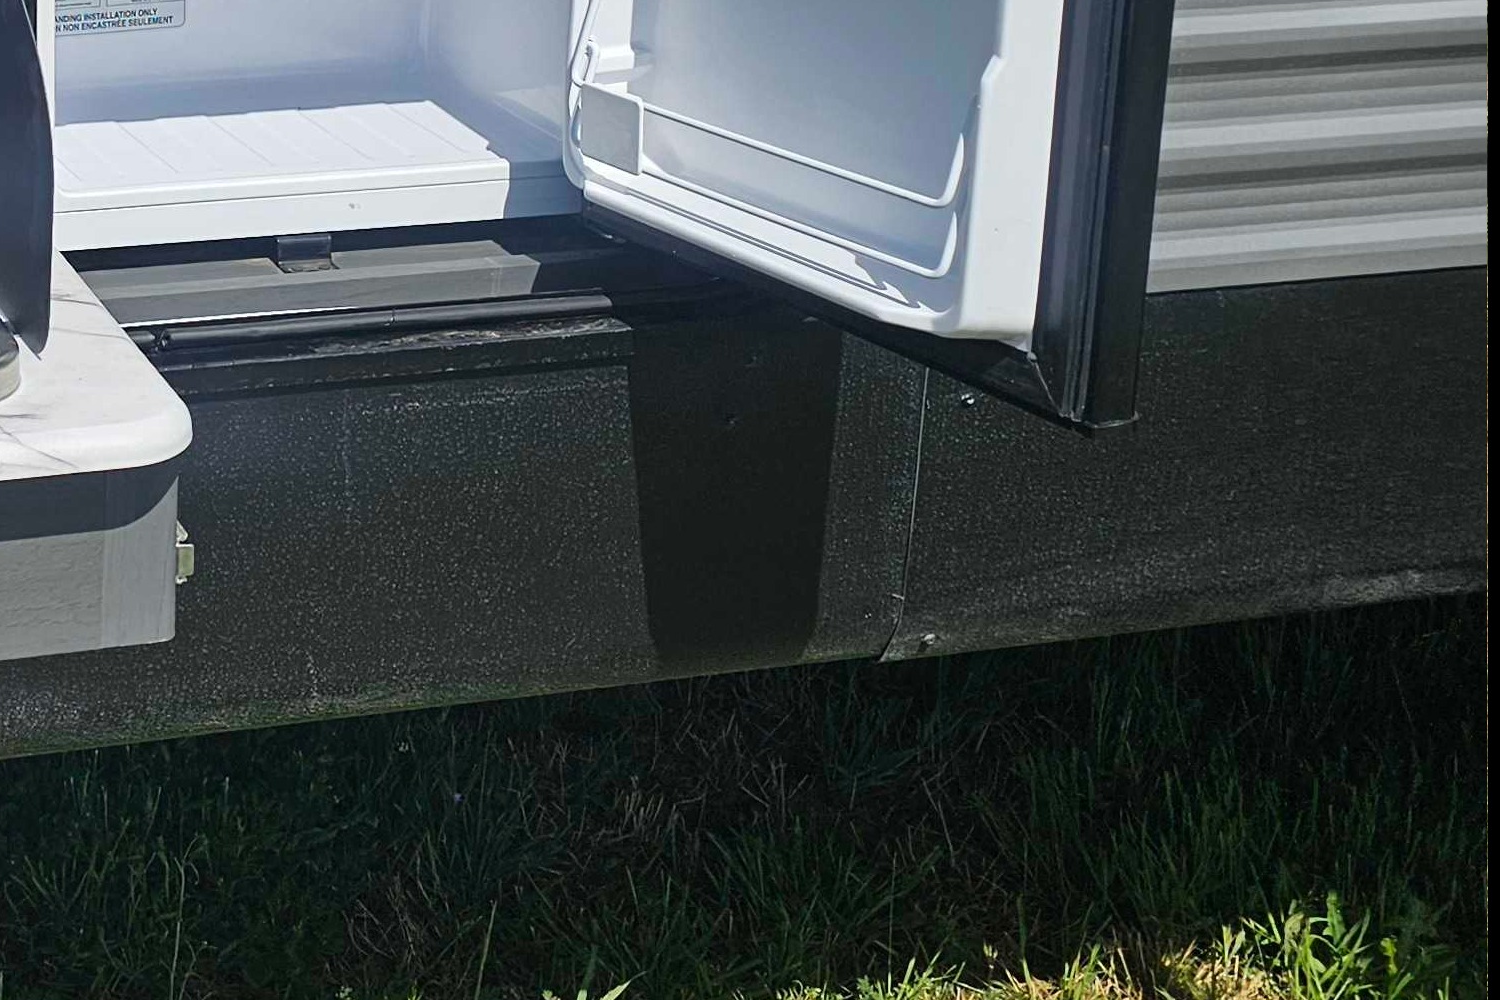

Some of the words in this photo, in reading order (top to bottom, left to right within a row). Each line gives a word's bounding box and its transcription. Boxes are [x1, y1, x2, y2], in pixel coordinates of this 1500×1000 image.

[84, 10, 137, 20] INSTALLATION
[138, 7, 158, 18] ONLY
[62, 23, 80, 32] NON
[128, 15, 174, 27] SEULEMENT
